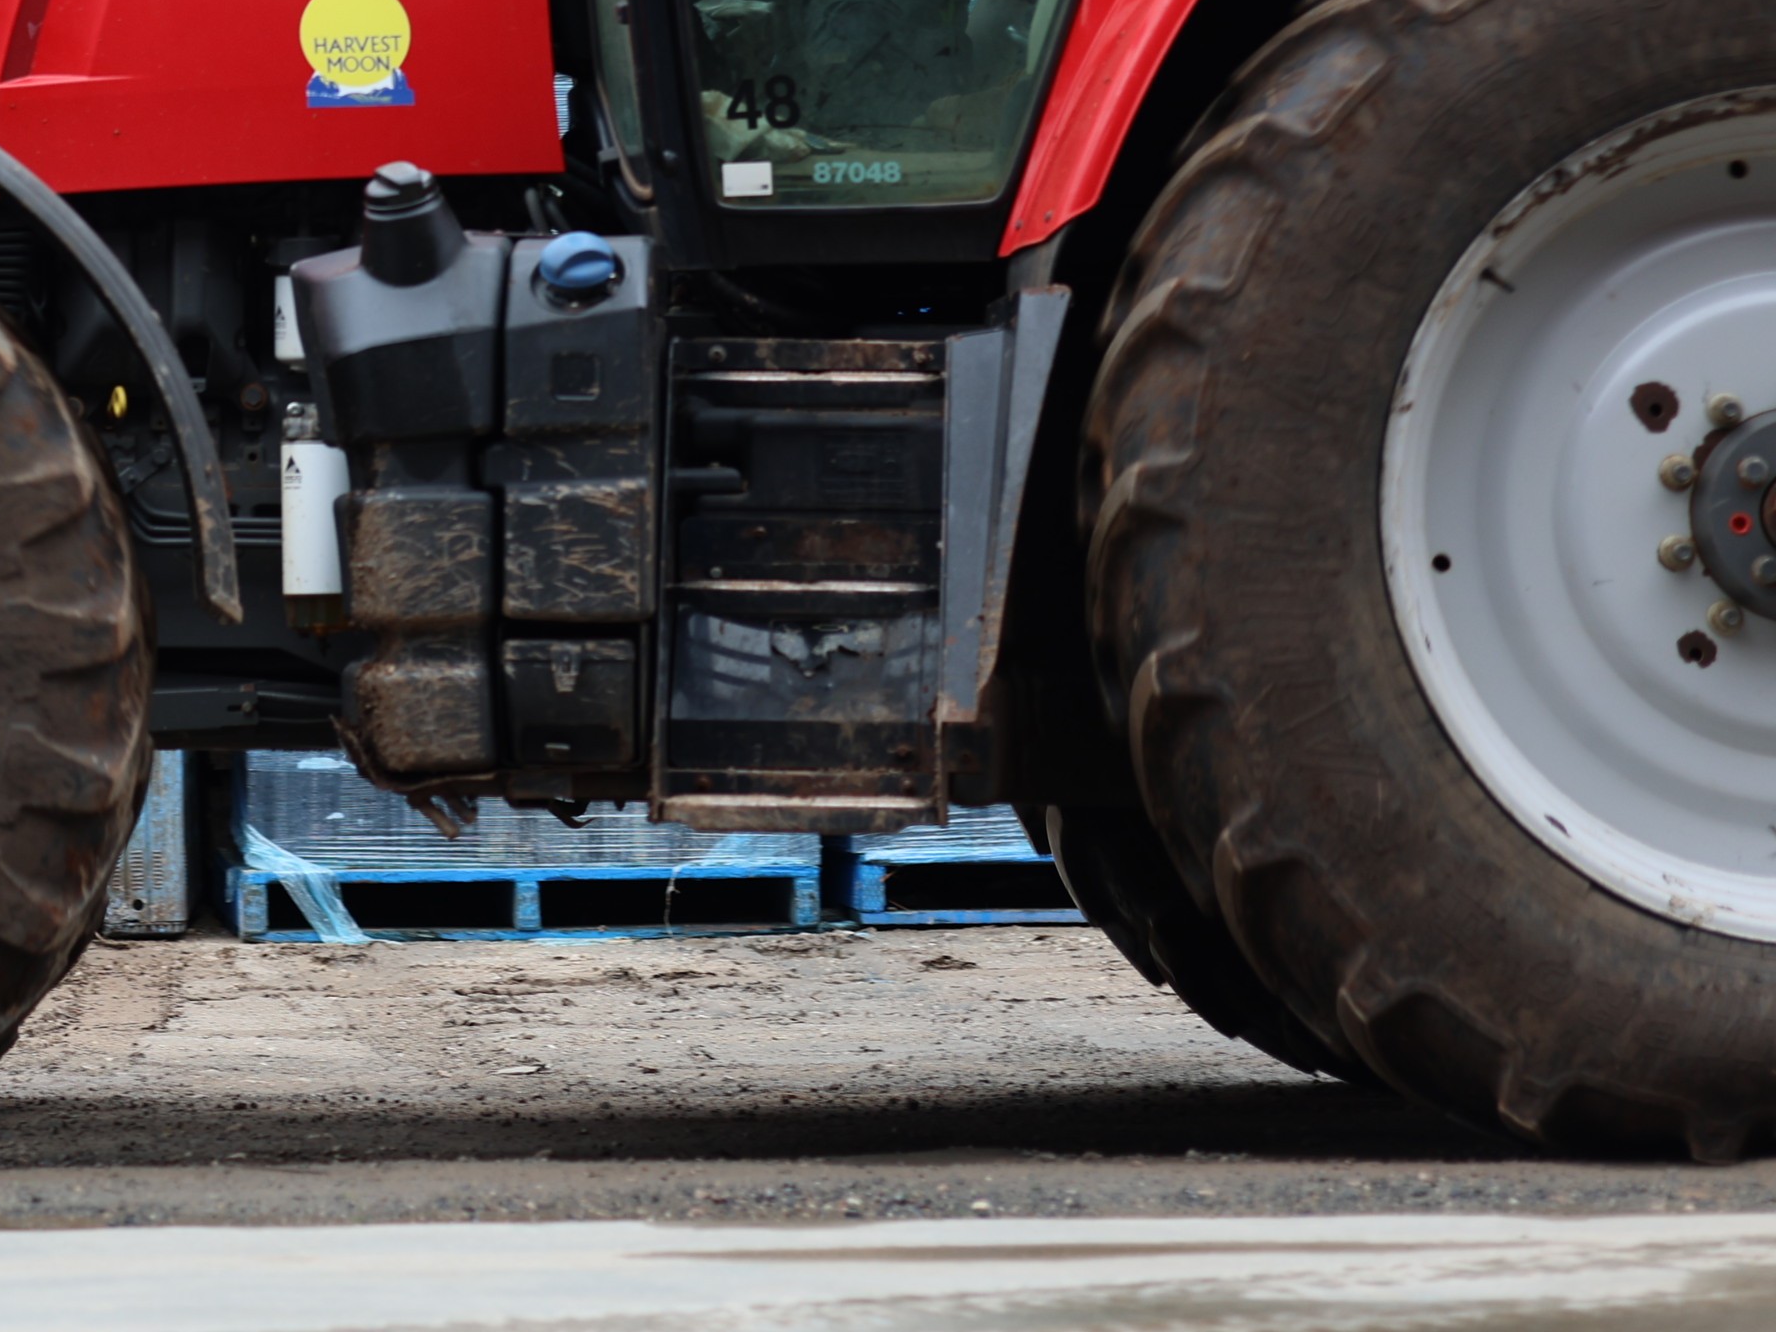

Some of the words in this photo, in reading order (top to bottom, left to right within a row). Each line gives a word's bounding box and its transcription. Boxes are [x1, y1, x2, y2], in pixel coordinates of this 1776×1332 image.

[314, 35, 402, 54] HARVEST
[327, 55, 391, 73] MOON
[726, 74, 801, 130] 48
[813, 161, 902, 184] 87048
